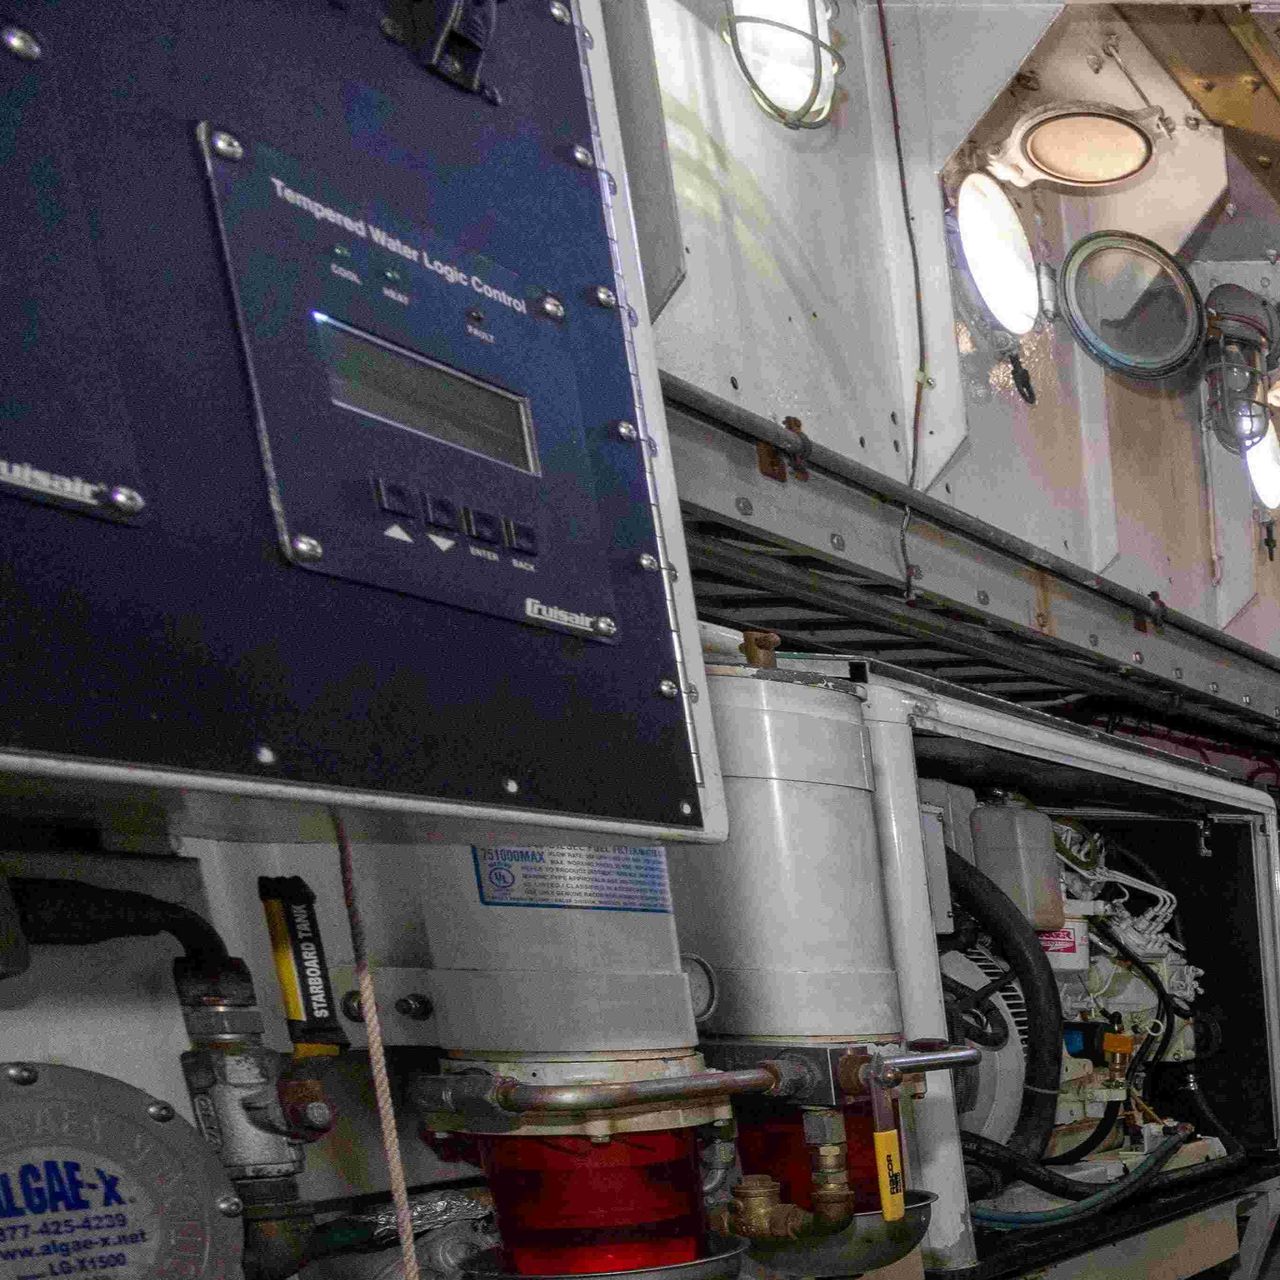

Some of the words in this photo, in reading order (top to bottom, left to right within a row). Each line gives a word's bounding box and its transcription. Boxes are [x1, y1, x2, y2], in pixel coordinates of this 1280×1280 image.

[270, 176, 367, 238] Tempered
[368, 224, 420, 262] Water
[422, 251, 468, 287] Logic
[471, 276, 528, 314] Control
[469, 546, 499, 562] ENTER
[512, 558, 536, 572] BACK
[292, 904, 313, 939] TANK
[301, 942, 329, 1018] STARBOARD
[0, 1160, 128, 1218] LGAE-X
